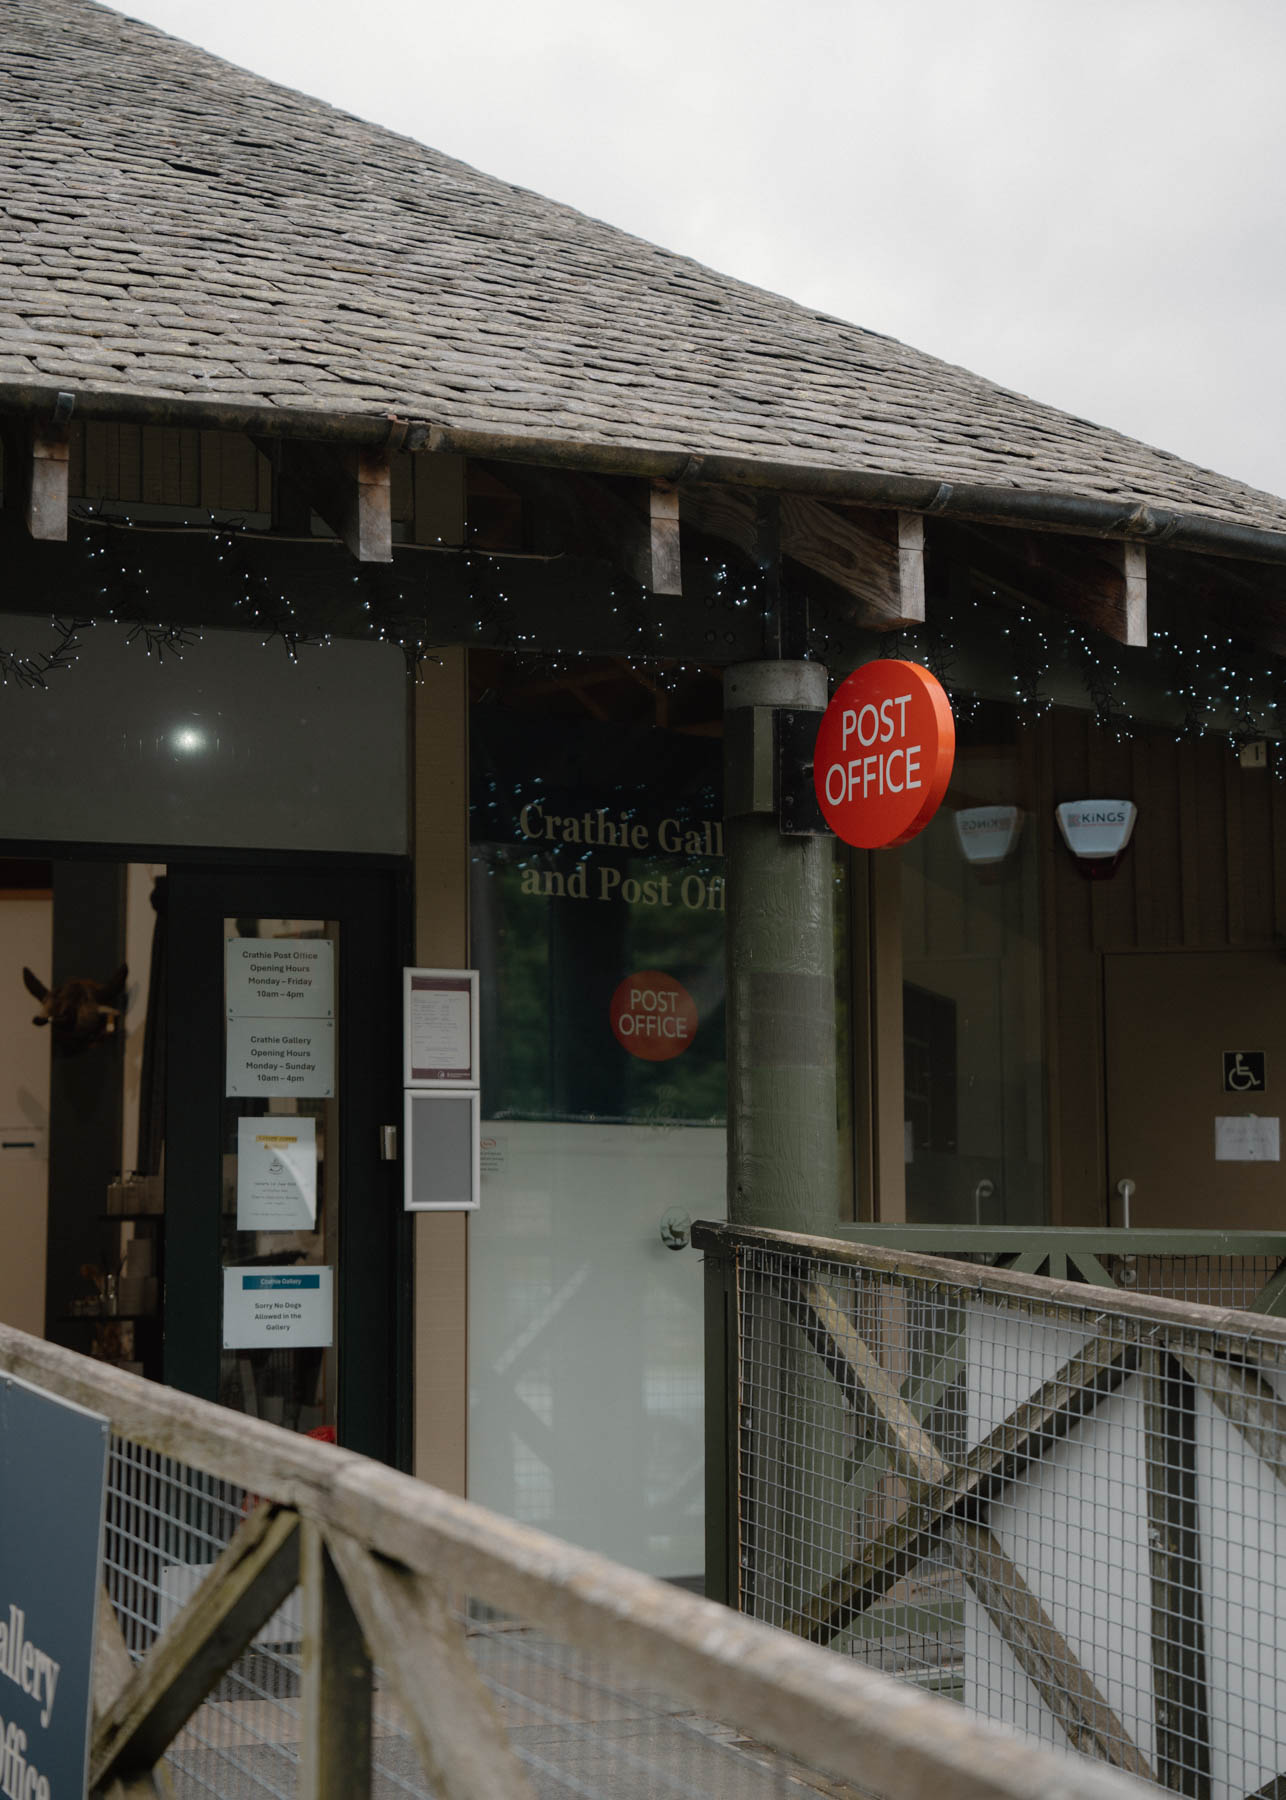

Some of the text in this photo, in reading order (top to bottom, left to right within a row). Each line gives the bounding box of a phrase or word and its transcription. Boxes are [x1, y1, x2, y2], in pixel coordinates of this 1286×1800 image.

[842, 694, 912, 751] POST
[825, 745, 921, 806] OFFICE
[519, 802, 649, 849] Crathie
[520, 862, 589, 899] and
[598, 867, 672, 906] Post
[242, 951, 272, 959] Crathie
[293, 952, 318, 960] Office
[250, 964, 310, 973] Opening Hours
[248, 977, 280, 986] Monday
[287, 977, 313, 986] Friday
[257, 990, 279, 998] 10am
[286, 991, 304, 999] 4pm
[630, 988, 679, 1013] POST
[618, 1013, 688, 1039] OFFICE
[282, 1036, 312, 1045] Gallery
[250, 1049, 311, 1057] Opening Hours
[246, 1062, 278, 1071] Monday
[285, 1062, 316, 1071] Sunday
[286, 1074, 304, 1083] 4pm
[254, 1302, 273, 1310] Sorry
[284, 1302, 302, 1310] Dogs
